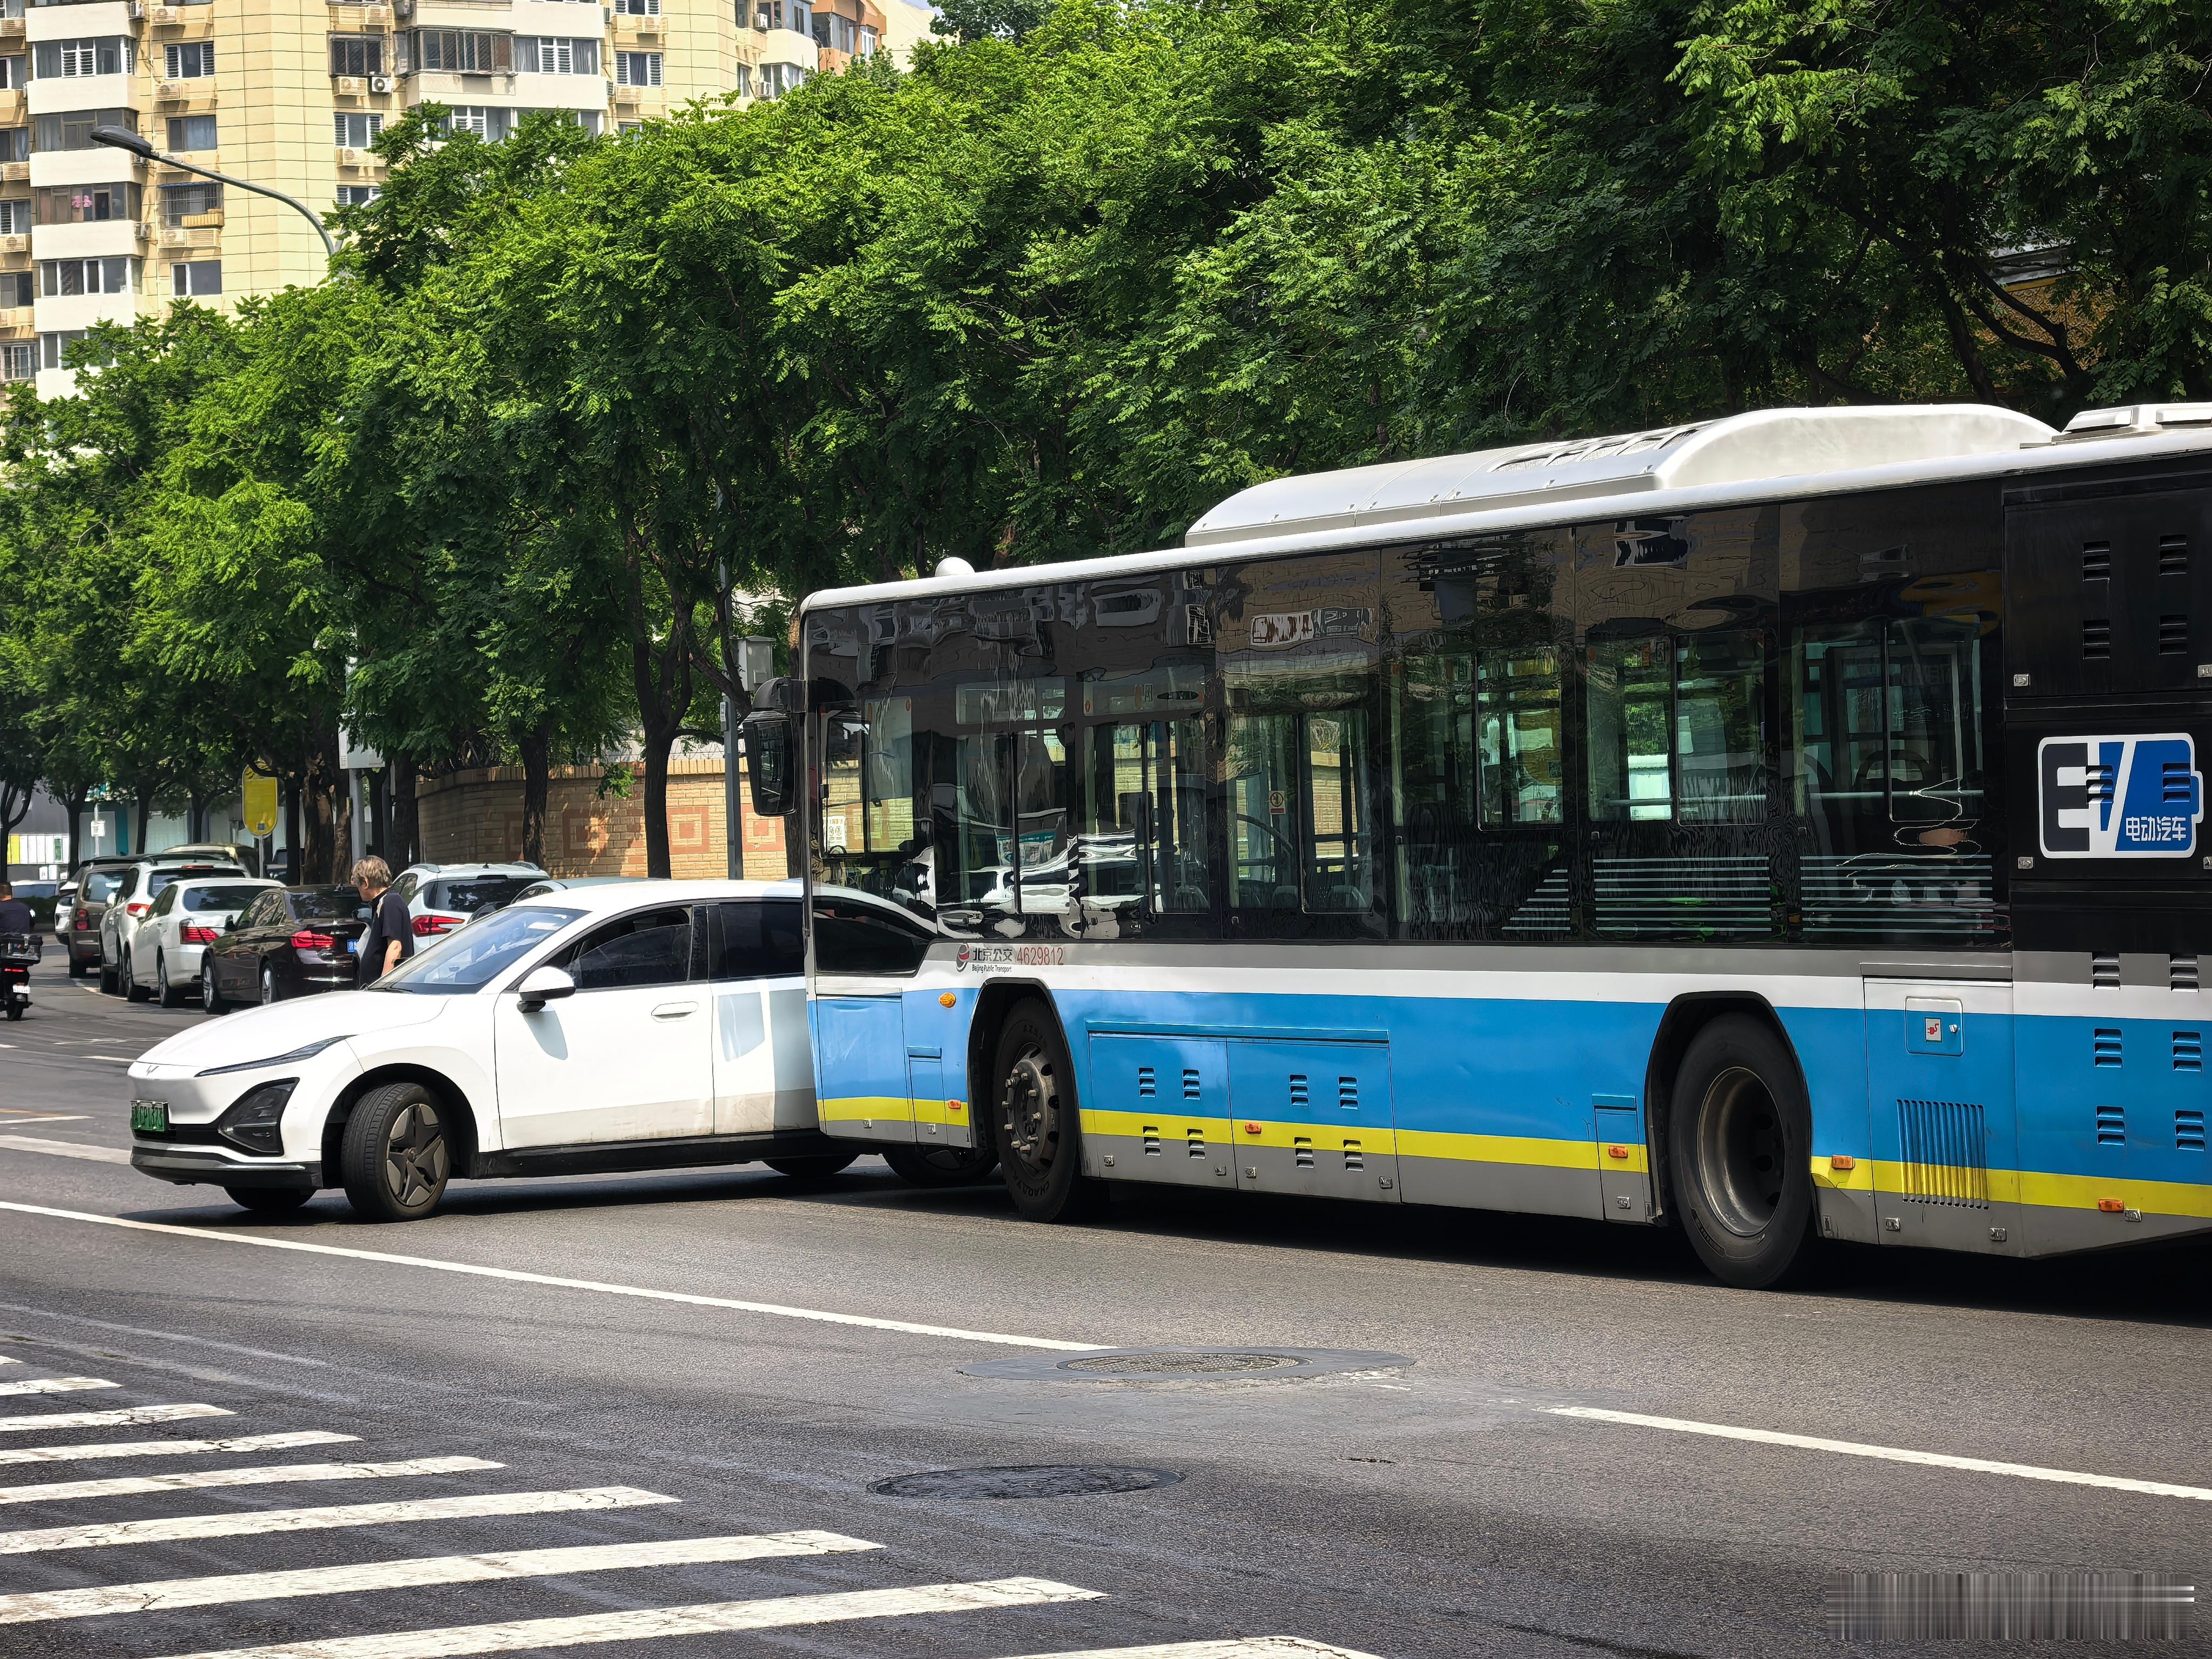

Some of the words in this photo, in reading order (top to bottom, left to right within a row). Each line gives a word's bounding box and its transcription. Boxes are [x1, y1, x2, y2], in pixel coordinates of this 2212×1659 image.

[2041, 740, 2137, 852] EV
[2126, 816, 2187, 841] 电动汽车
[973, 947, 1013, 962] 北京公交
[1017, 946, 1064, 966] 4629812
[995, 965, 1012, 974] Transport
